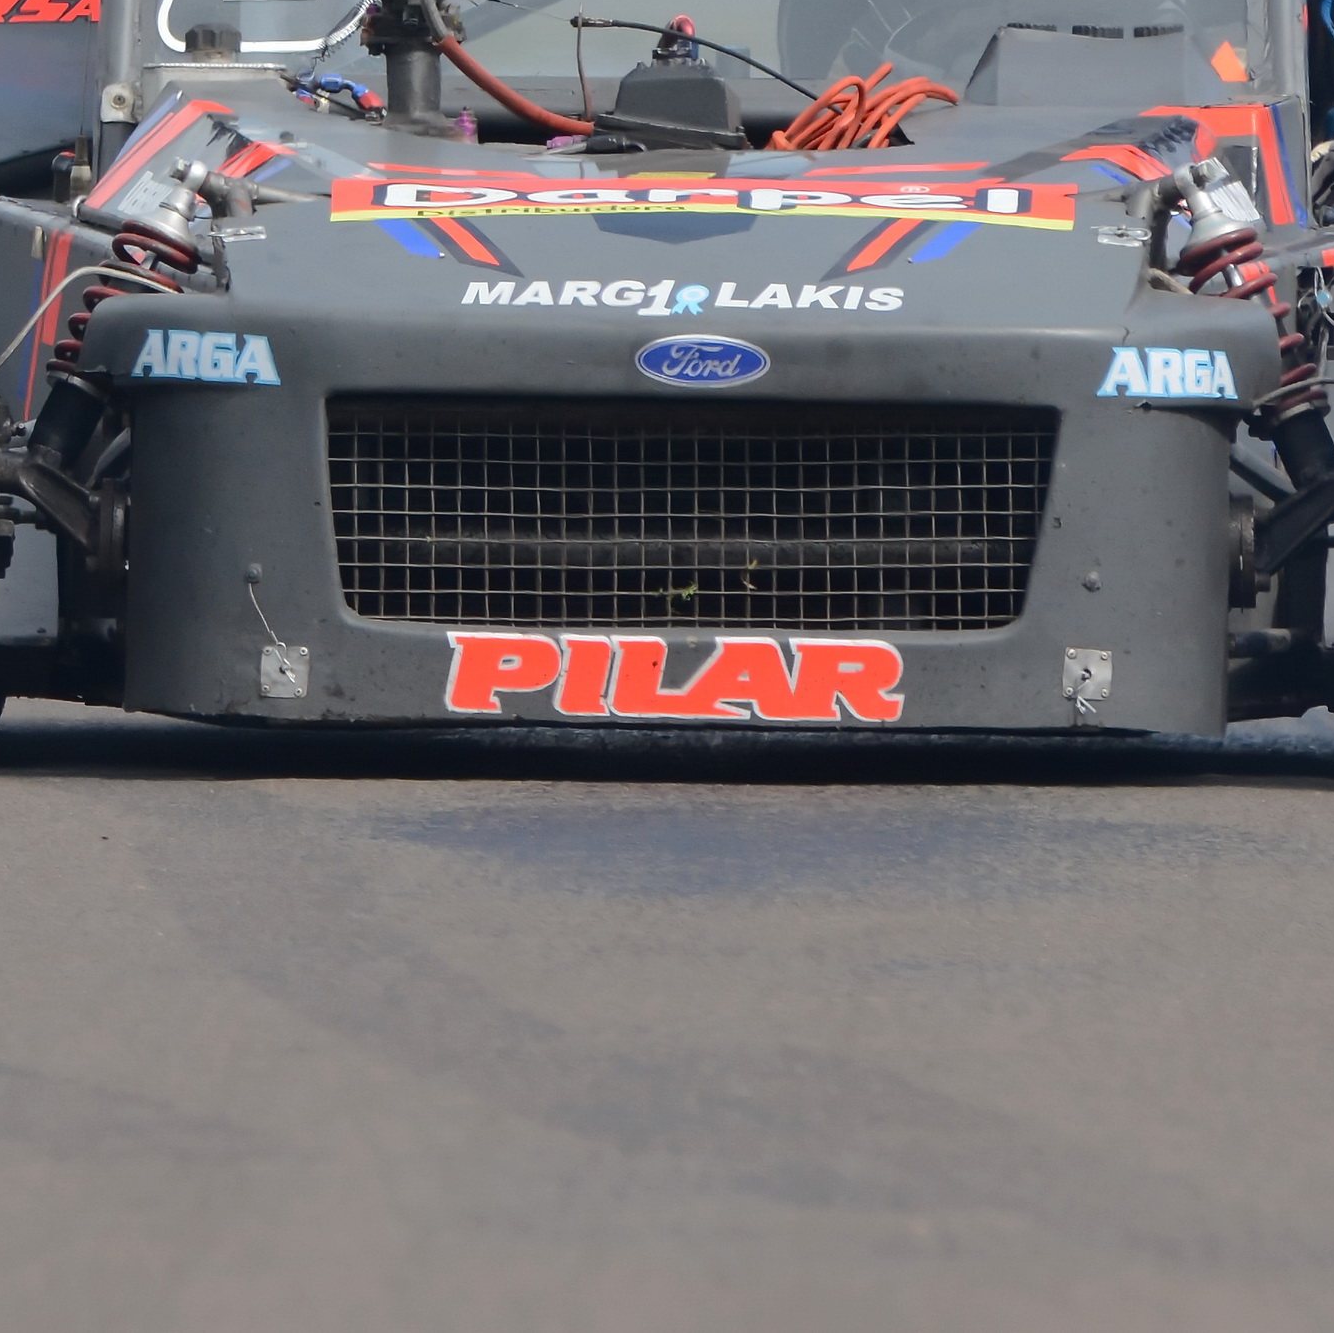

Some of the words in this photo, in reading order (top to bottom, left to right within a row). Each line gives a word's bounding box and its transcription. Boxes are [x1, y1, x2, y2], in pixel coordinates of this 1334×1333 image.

[374, 183, 1033, 214] Darpel
[416, 204, 687, 218] Distribuidora
[131, 328, 281, 386] ARGA
[661, 342, 741, 382] Ford
[1096, 346, 1239, 400] ARGA
[445, 631, 905, 723] PILAR
